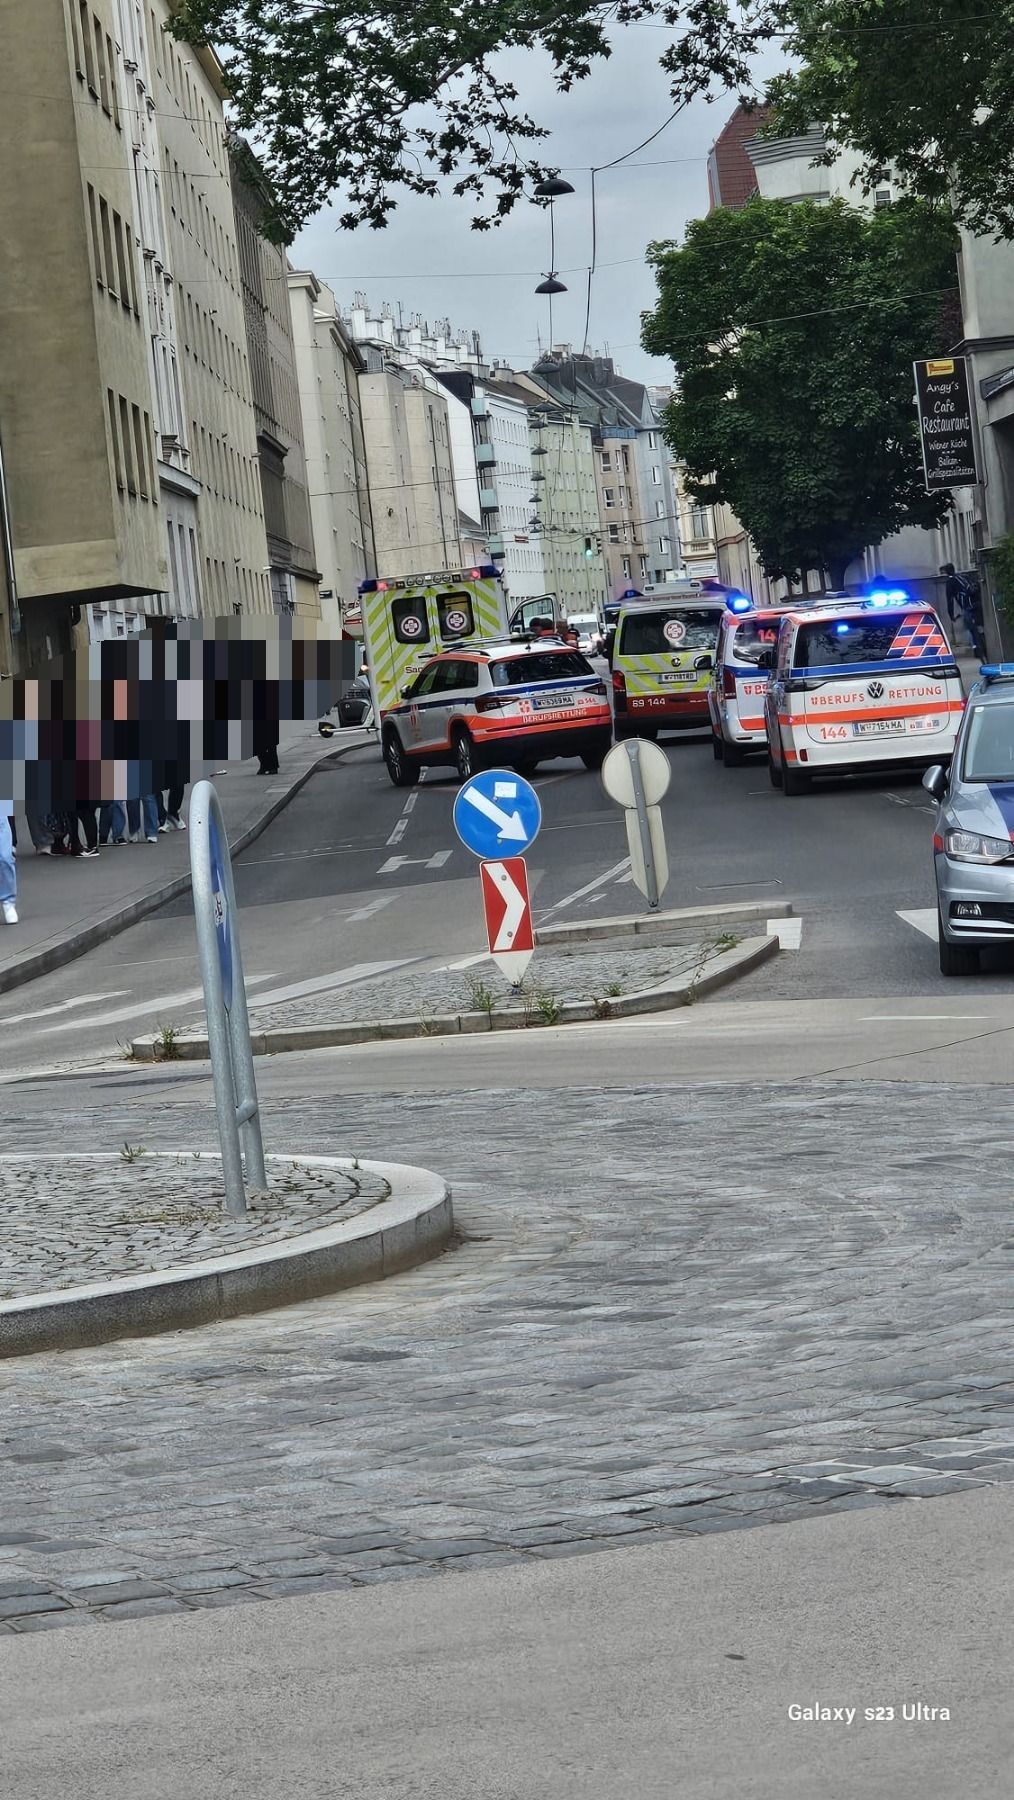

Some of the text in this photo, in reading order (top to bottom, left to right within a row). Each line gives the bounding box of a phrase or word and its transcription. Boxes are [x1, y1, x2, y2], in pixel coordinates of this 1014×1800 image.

[934, 399, 956, 413] Cafe
[923, 412, 970, 434] Restaurant
[929, 440, 949, 451] Wiener
[647, 698, 666, 706] 144
[820, 693, 865, 705] BERUFS
[888, 686, 942, 699] RETTUNG
[522, 708, 587, 723] BERUFSRETTUNG
[820, 726, 848, 739] 144
